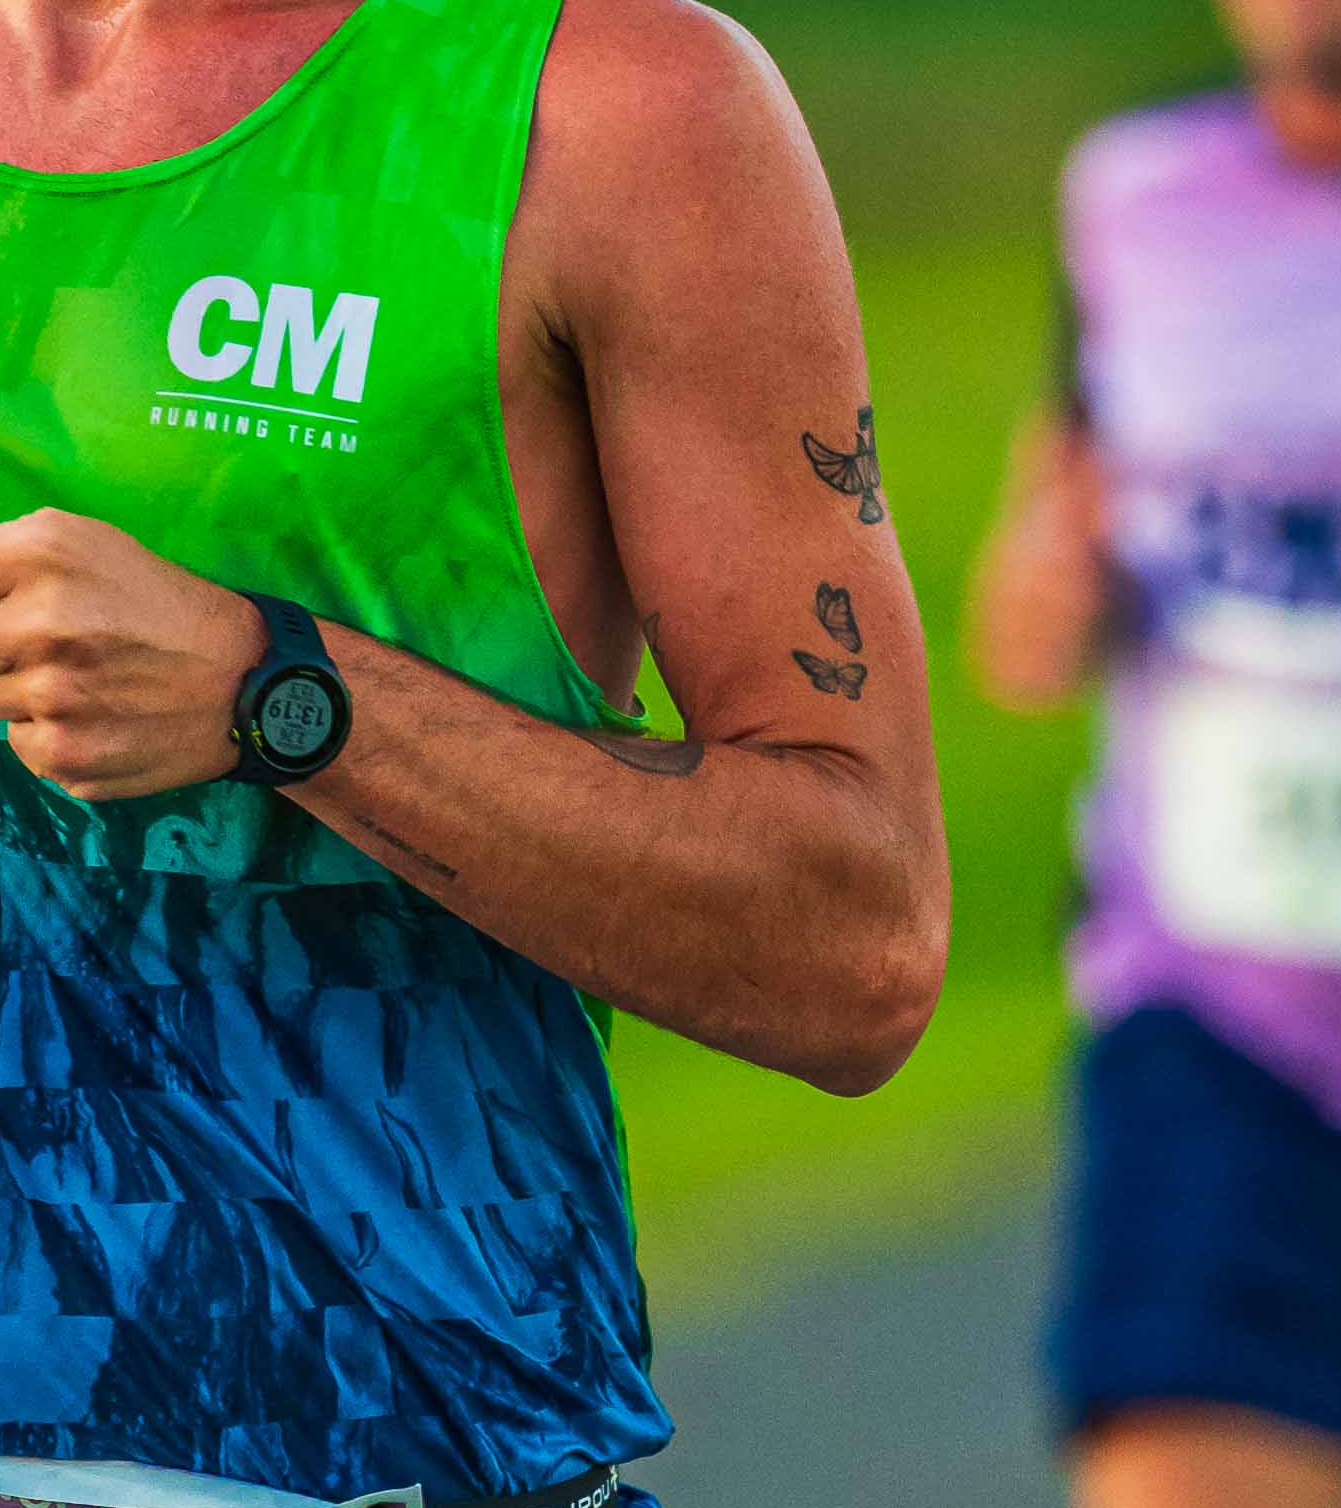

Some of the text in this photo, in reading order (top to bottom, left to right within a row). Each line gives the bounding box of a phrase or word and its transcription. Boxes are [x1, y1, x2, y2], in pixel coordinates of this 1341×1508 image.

[167, 275, 380, 403] CM
[150, 406, 357, 453] RUNNING TEAM
